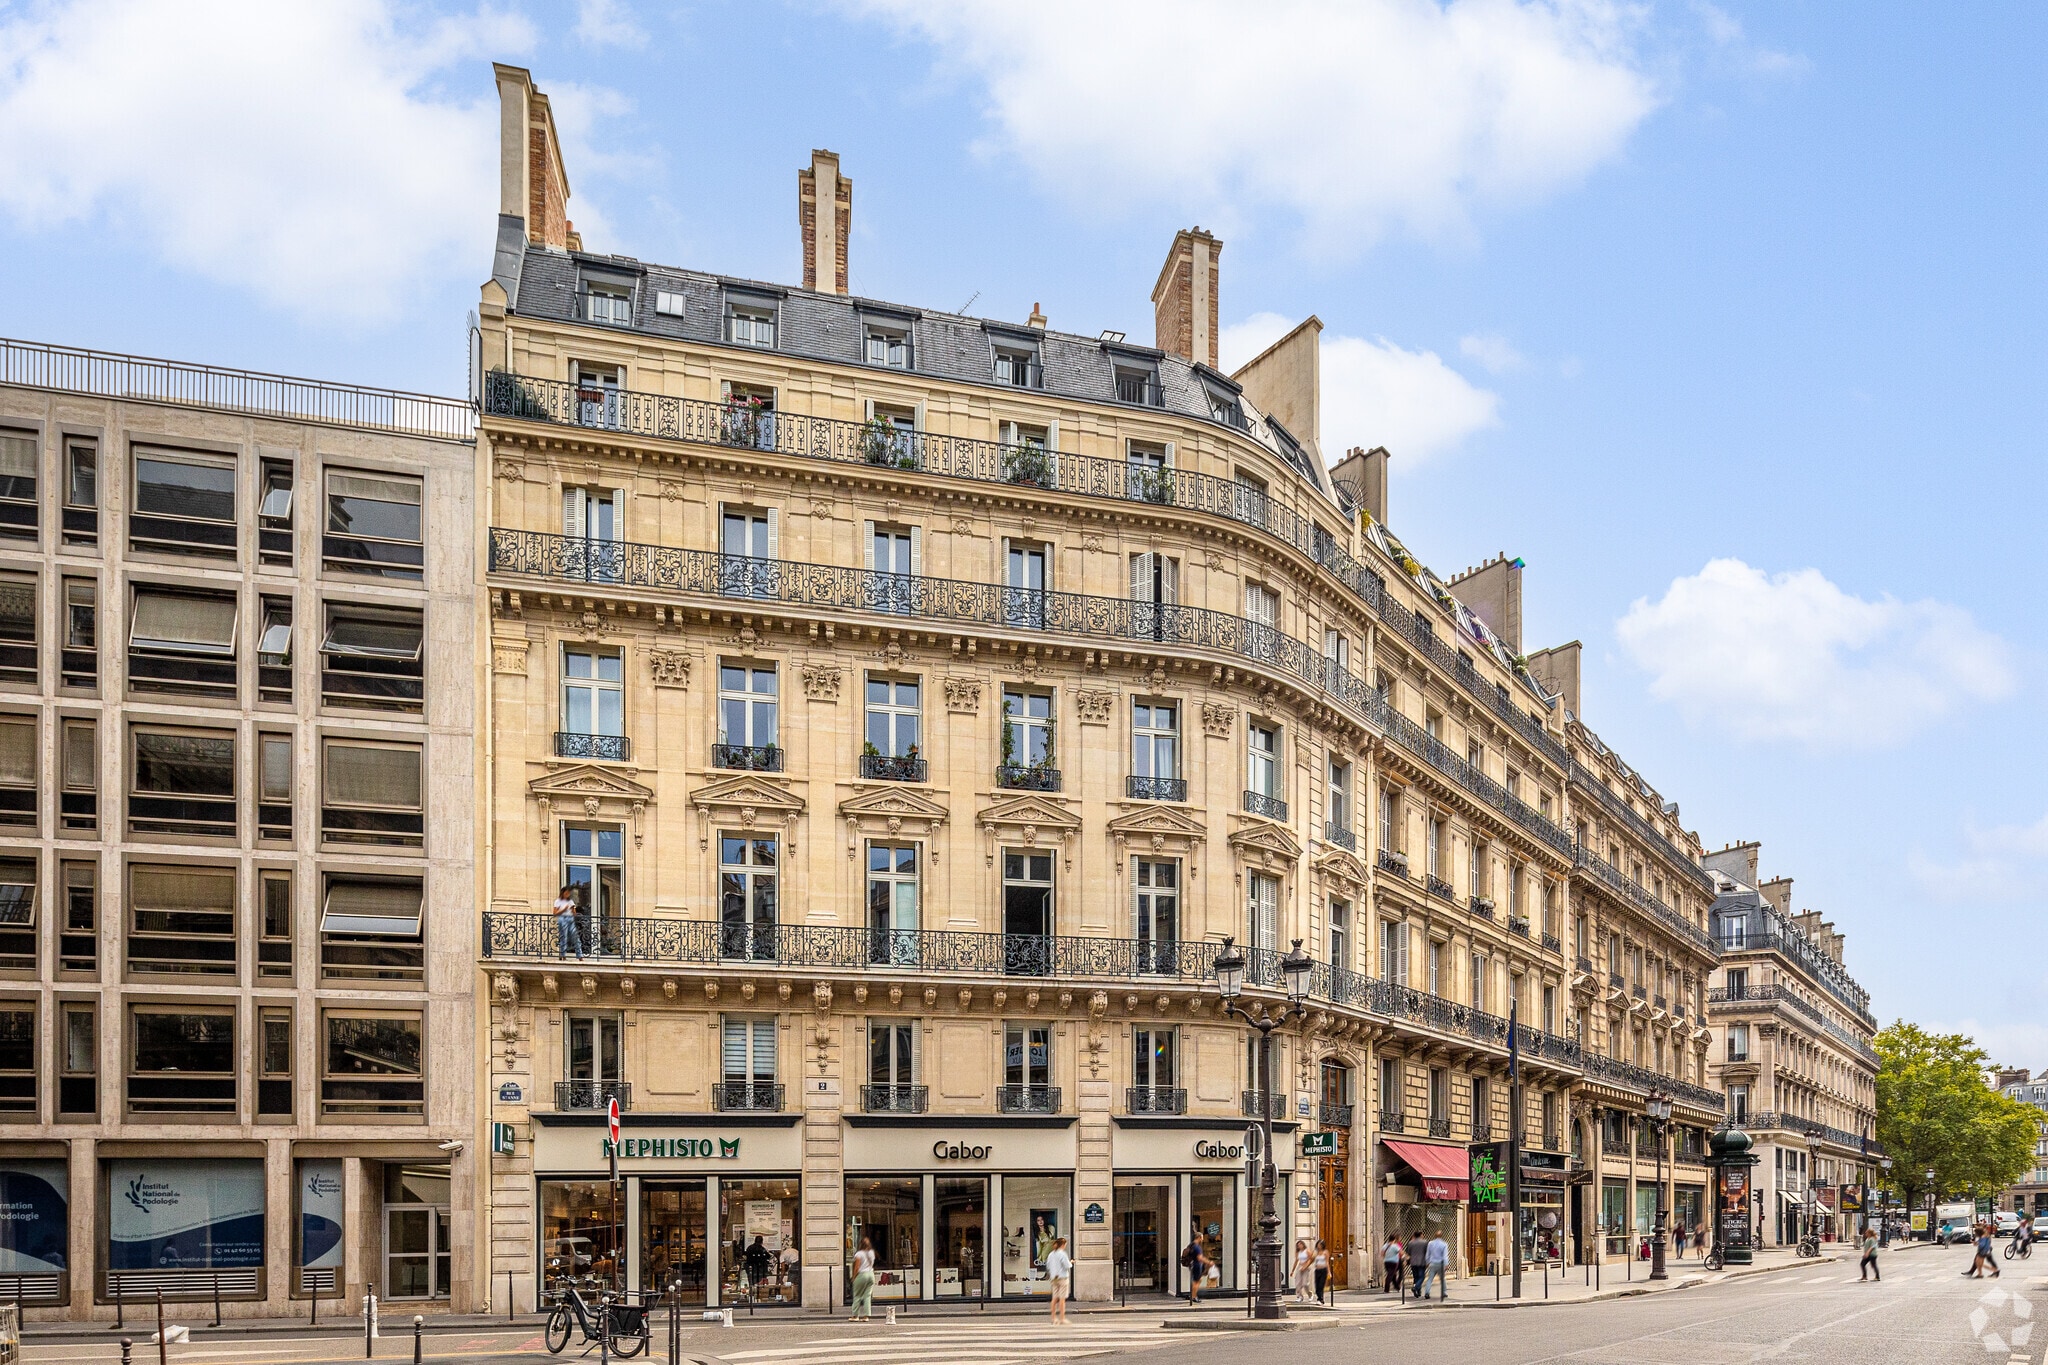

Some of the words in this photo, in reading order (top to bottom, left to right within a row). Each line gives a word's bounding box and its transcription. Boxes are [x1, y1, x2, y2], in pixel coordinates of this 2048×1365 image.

[602, 1138, 713, 1157] MEPHISTO
[933, 1140, 993, 1159] Gabor
[1194, 1139, 1244, 1159] Gabor
[1305, 1145, 1333, 1154] MEPHISTO
[142, 1198, 179, 1206] Podologie
[1473, 1187, 1502, 1203] TAL
